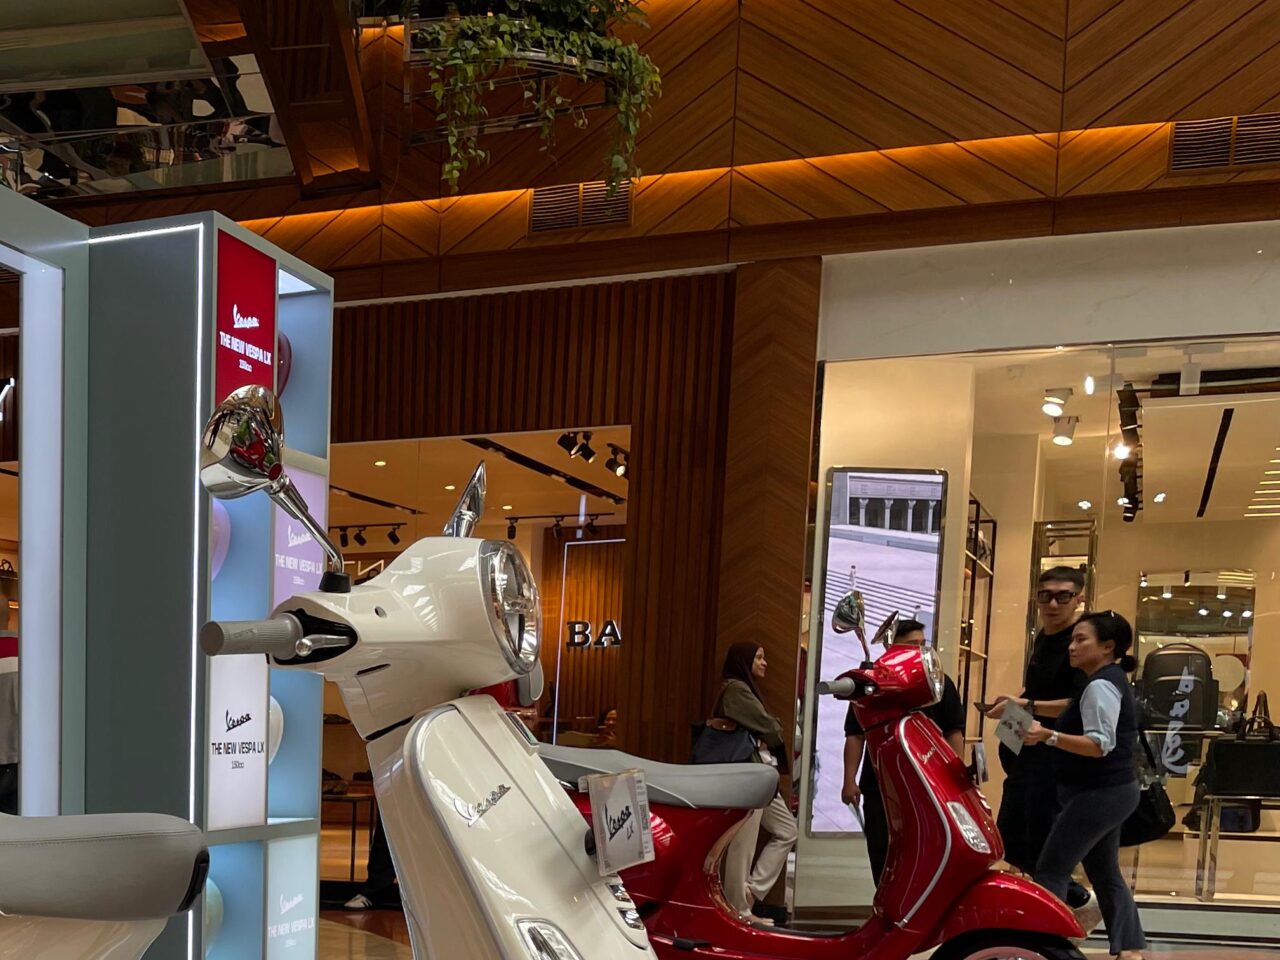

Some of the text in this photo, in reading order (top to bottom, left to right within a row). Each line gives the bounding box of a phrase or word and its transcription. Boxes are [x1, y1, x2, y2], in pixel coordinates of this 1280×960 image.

[211, 741, 265, 755] THE NEW VESPA LX
